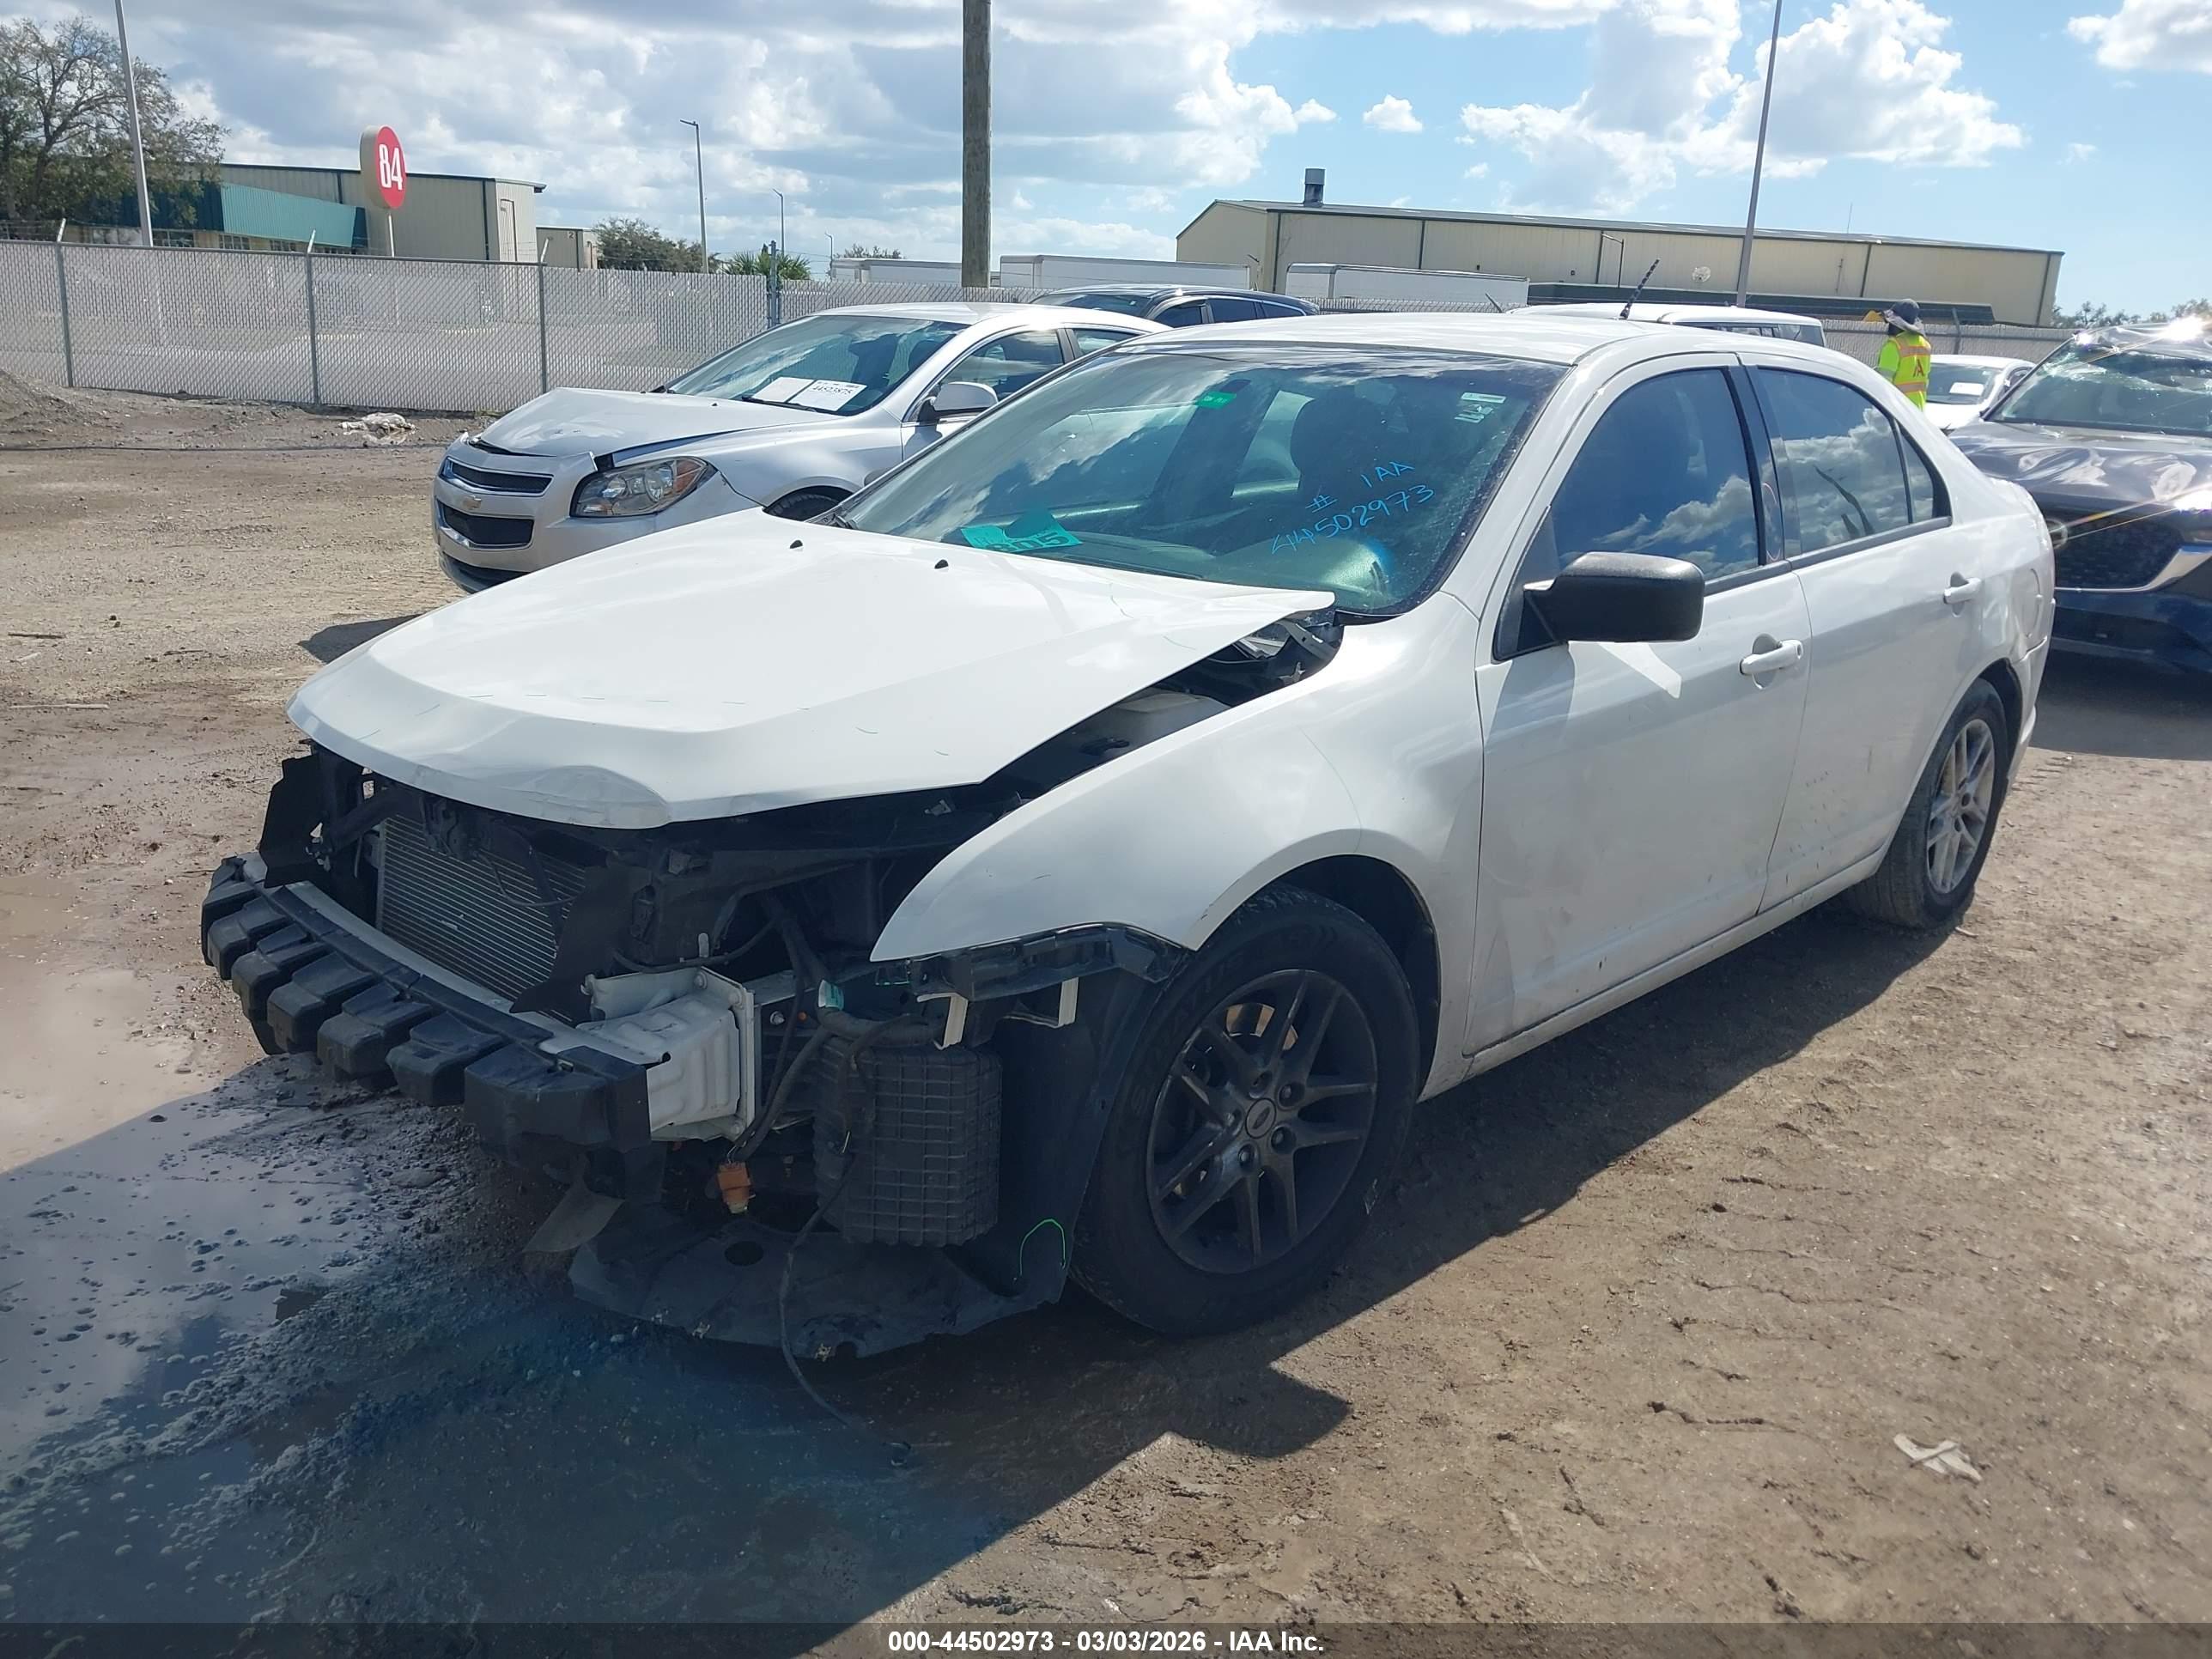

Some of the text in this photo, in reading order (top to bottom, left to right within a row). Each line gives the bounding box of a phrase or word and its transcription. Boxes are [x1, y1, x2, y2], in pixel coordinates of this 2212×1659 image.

[379, 143, 403, 191] 84
[1305, 461, 1415, 514] # IAA
[1272, 483, 1435, 555] 44502973
